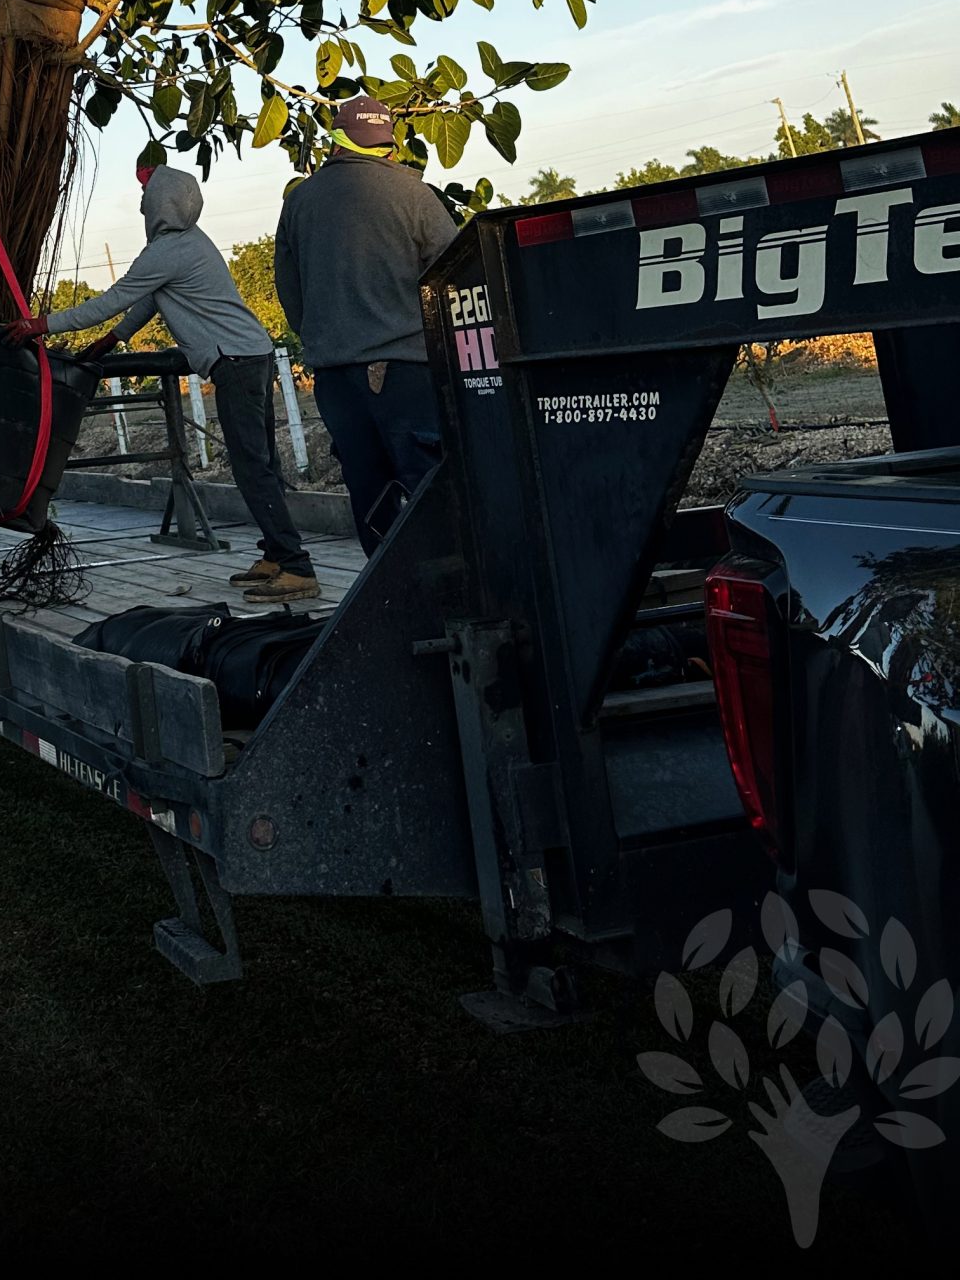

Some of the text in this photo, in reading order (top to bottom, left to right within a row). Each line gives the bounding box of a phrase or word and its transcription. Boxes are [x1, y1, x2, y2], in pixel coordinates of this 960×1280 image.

[463, 377, 490, 389] TORQUE
[537, 391, 660, 411] TROPICTRAILER.COM
[544, 407, 657, 424] 1-800-897-4430
